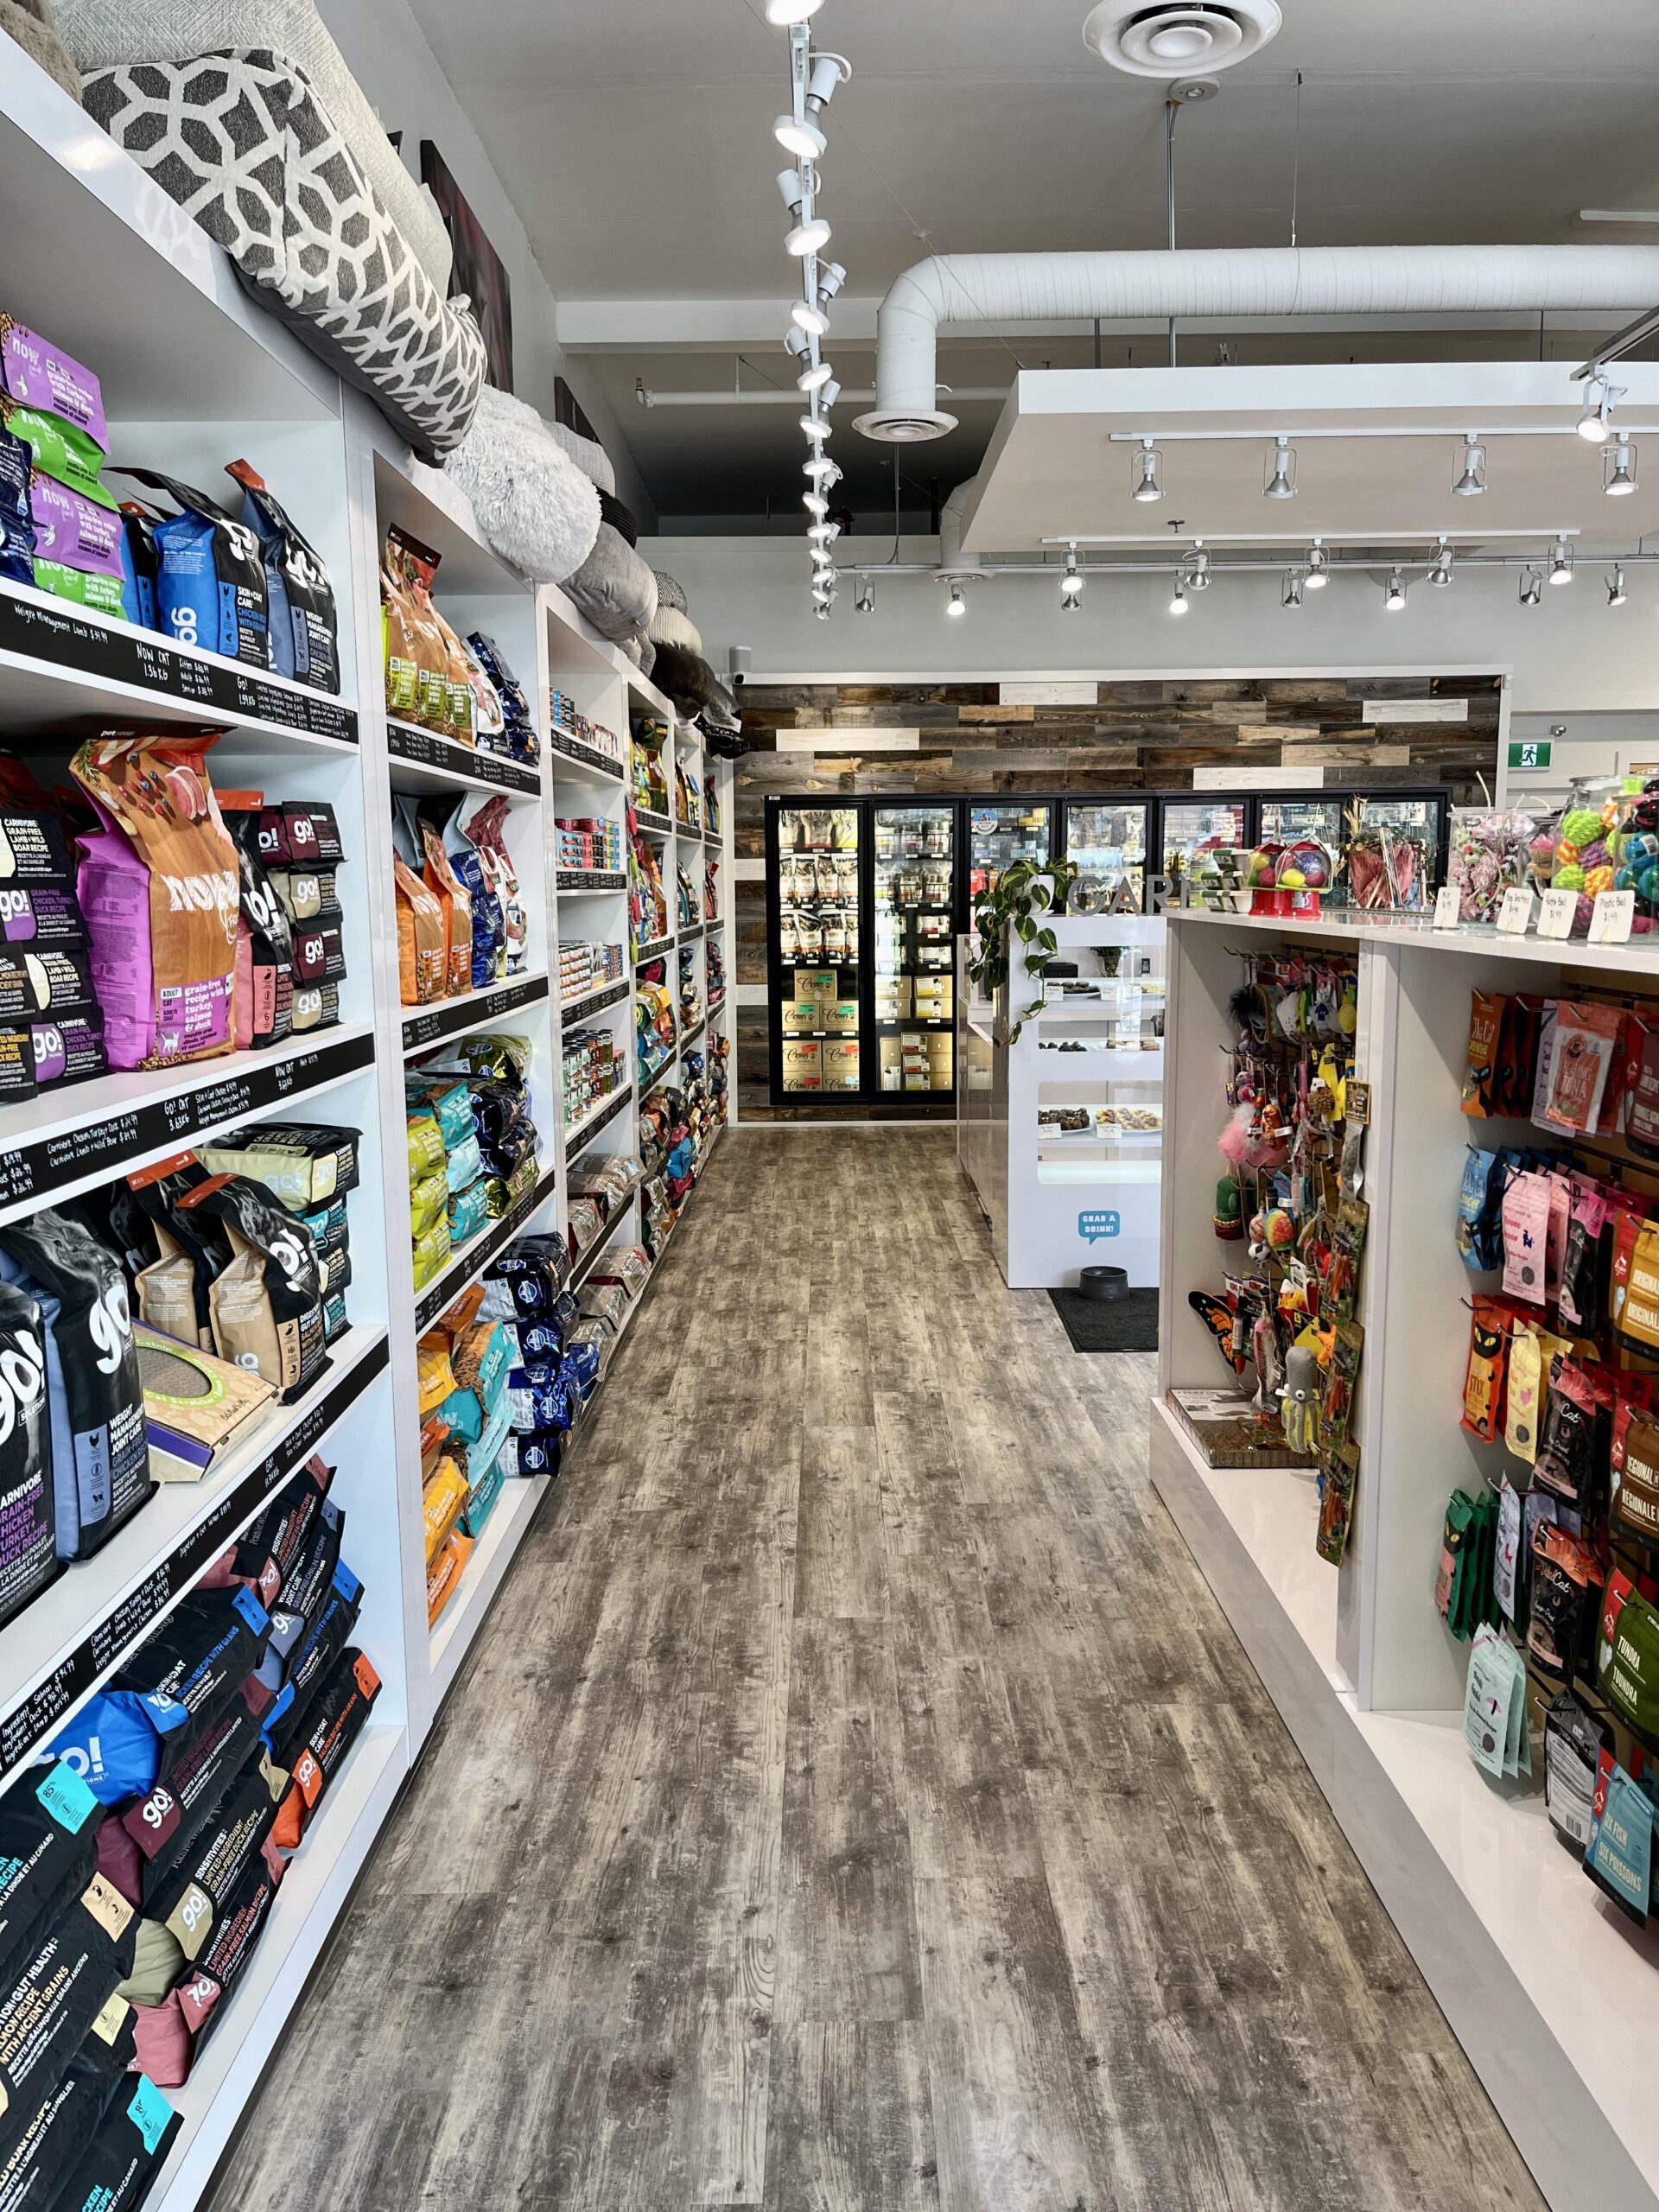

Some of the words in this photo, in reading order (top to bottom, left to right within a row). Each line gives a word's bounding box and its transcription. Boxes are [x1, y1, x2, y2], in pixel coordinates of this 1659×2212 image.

[13, 336, 40, 365] now
[41, 487, 70, 510] now
[237, 596, 253, 608] CARE
[37, 612, 71, 632] Management
[73, 623, 87, 638] Lamb
[137, 643, 154, 663] NOW
[158, 652, 170, 666] CAT
[4, 818, 38, 827] CARNIVORE
[294, 819, 315, 843] go!
[159, 872, 238, 912] now
[297, 876, 319, 904] go!
[1617, 896, 1627, 907] Ball
[0, 890, 30, 922] go!
[305, 930, 325, 964] go!
[50, 975, 63, 983] BOAR
[185, 980, 221, 996] grain-free
[186, 993, 209, 1004] recipe
[211, 987, 224, 997] with
[297, 988, 322, 1015] go!
[57, 1019, 87, 1029] CARNIVORE
[185, 1011, 212, 1024] salmon
[194, 1020, 212, 1031] duck
[33, 1028, 63, 1063] go!
[1561, 1075, 1586, 1099] TUNA
[164, 1101, 176, 1116] GO!
[179, 1097, 189, 1110] CAT
[47, 1141, 73, 1154] Carnivore
[50, 1152, 74, 1167] Carnivore
[1627, 1304, 1659, 1328] ORIGINAL
[109, 1404, 133, 1431] WEIGHT
[1560, 1402, 1580, 1423] Cat
[111, 1434, 130, 1456] JOINT
[129, 1421, 143, 1442] CARE
[0, 1471, 41, 1509] ARNIVORE
[1622, 1488, 1656, 1522] RÉGIONALE
[22, 1520, 48, 1552] RECIPE
[10, 1564, 27, 1580] DINDE
[1553, 1573, 1570, 1592] Cat
[1618, 1635, 1640, 1671] TUNDRA
[1613, 1665, 1637, 1706] TOUNDRA
[2, 1704, 30, 1738] Ingredient
[34, 1684, 53, 1704] Salmon
[2, 1722, 28, 1752] Ingredient
[29, 1707, 42, 1724] Duck
[315, 1735, 326, 1753] CARE
[299, 1752, 316, 1788] go!
[143, 1787, 173, 1828] go!
[219, 1819, 245, 1859] INGREDIENT
[1604, 1811, 1613, 1832] SIX
[1612, 1822, 1628, 1847] FISH
[195, 1829, 226, 1881] SENSITIVITIES
[1599, 1841, 1610, 1861] SIX
[1609, 1852, 1642, 1891] POISSONS
[181, 1888, 207, 1932] go!
[27, 1941, 55, 1987] HEALTH
[41, 1966, 69, 2004] GRAINS
